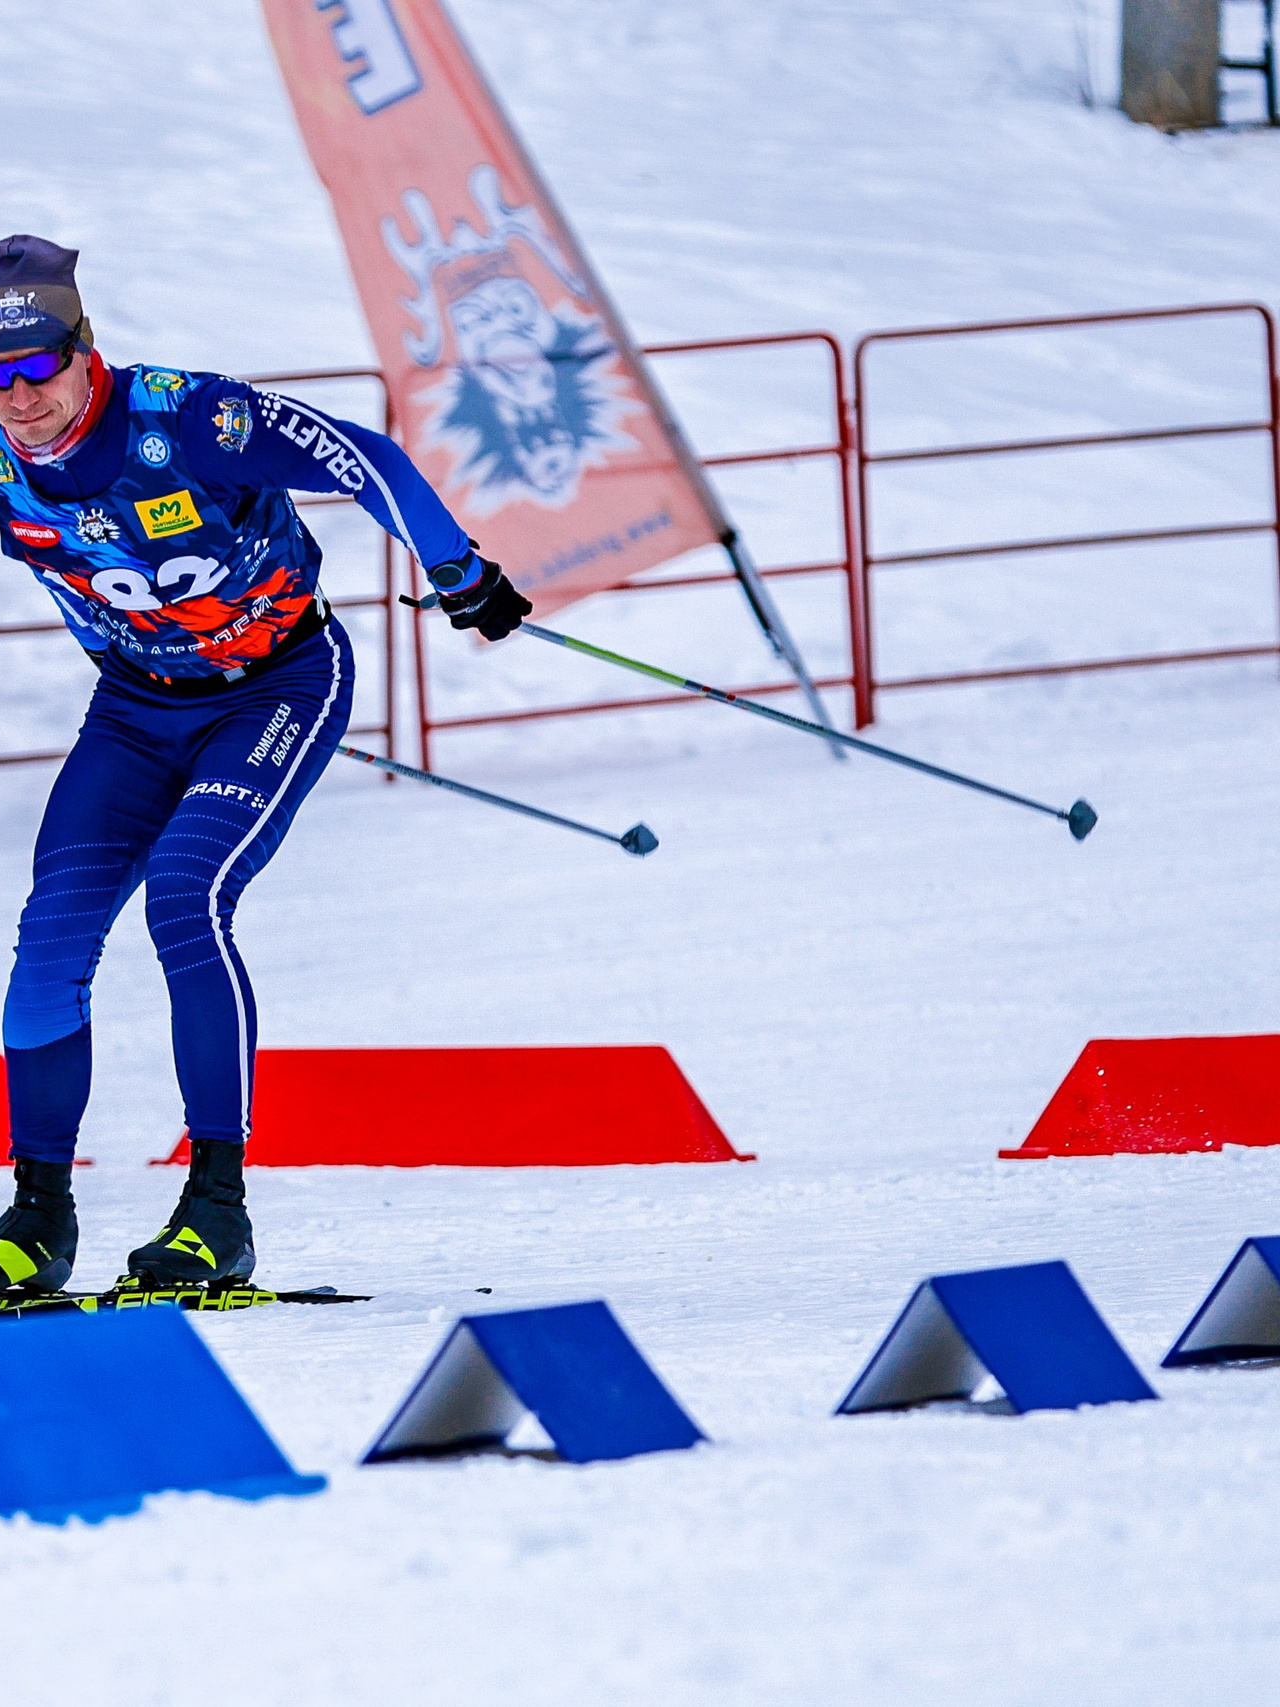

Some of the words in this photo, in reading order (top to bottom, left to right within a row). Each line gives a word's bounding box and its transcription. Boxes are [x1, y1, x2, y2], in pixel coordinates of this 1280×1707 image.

[278, 413, 365, 494] CRAFT
[246, 702, 292, 767] ТЮМЕНСКАЯ
[271, 722, 301, 767] ОБЛАСТЬ
[183, 782, 253, 801] CRAFT
